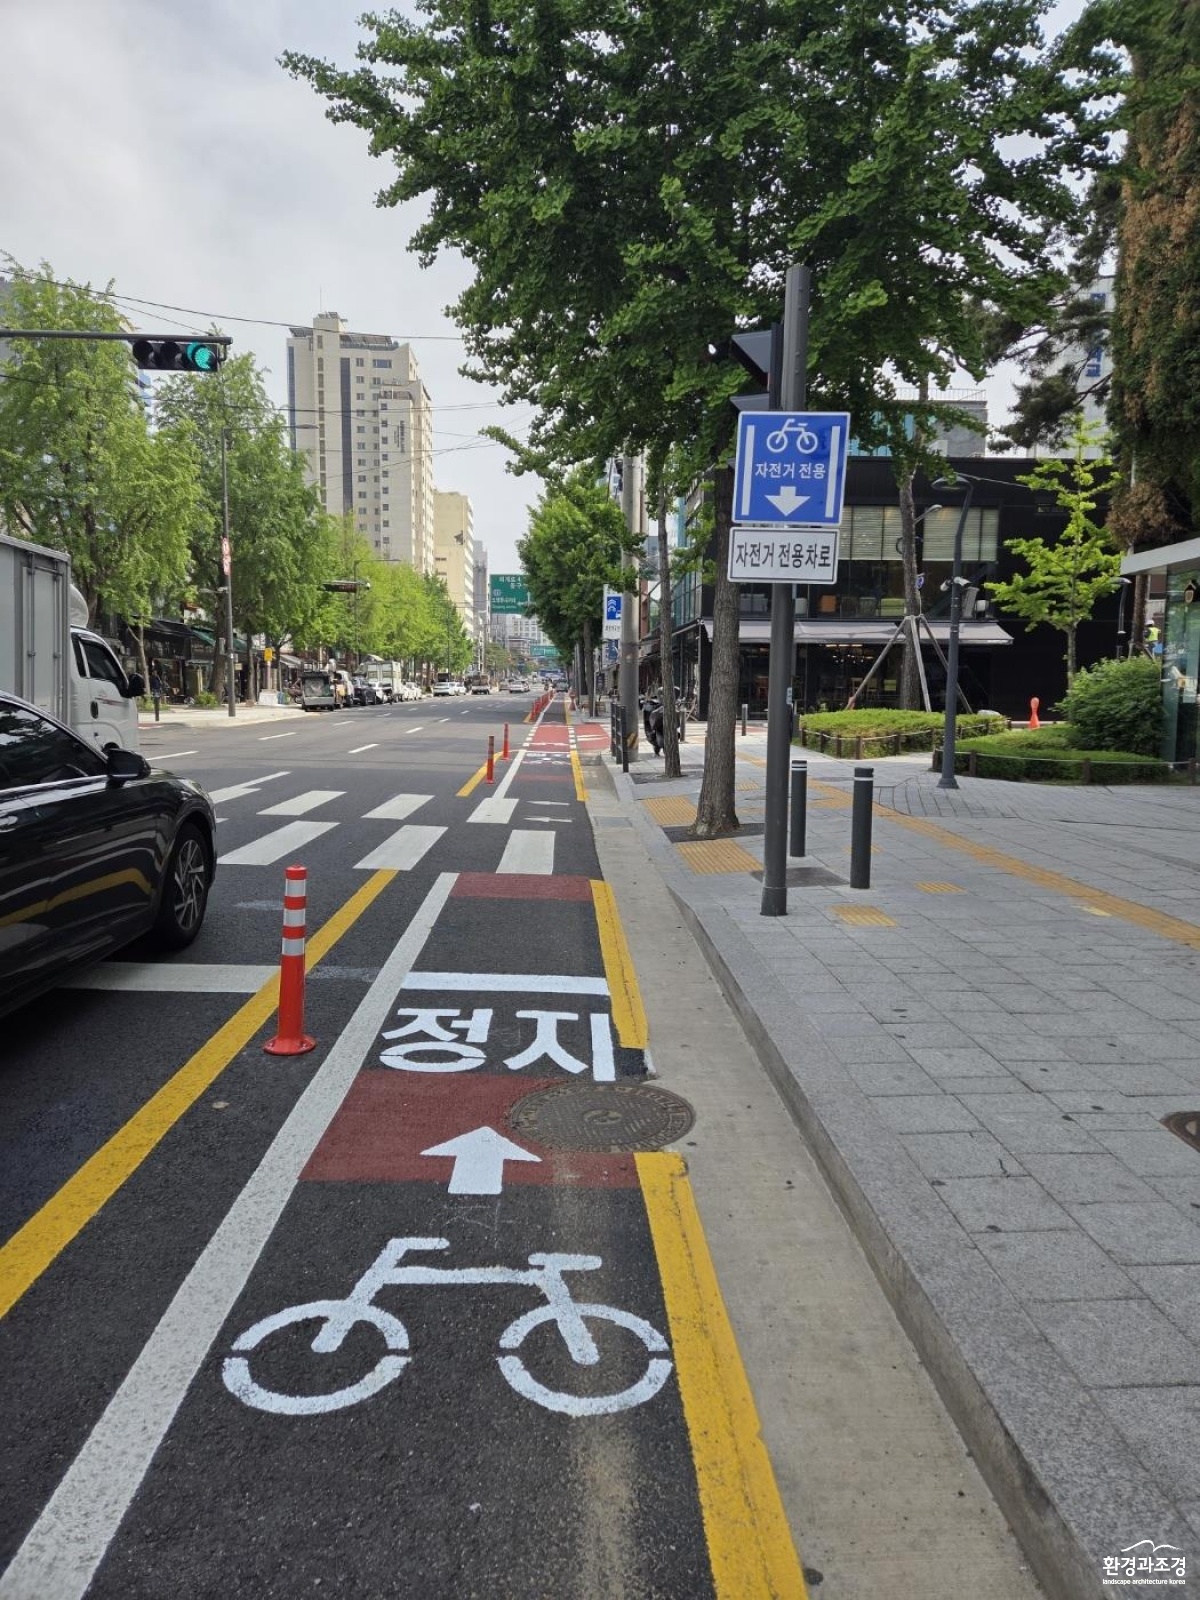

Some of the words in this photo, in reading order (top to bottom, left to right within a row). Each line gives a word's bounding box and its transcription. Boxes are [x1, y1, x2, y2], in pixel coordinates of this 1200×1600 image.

[755, 462, 796, 479] 자전거
[798, 462, 826, 479] 전용
[736, 541, 775, 568] 자전거
[778, 542, 831, 569] 전용차로
[379, 1007, 617, 1082] 정지
